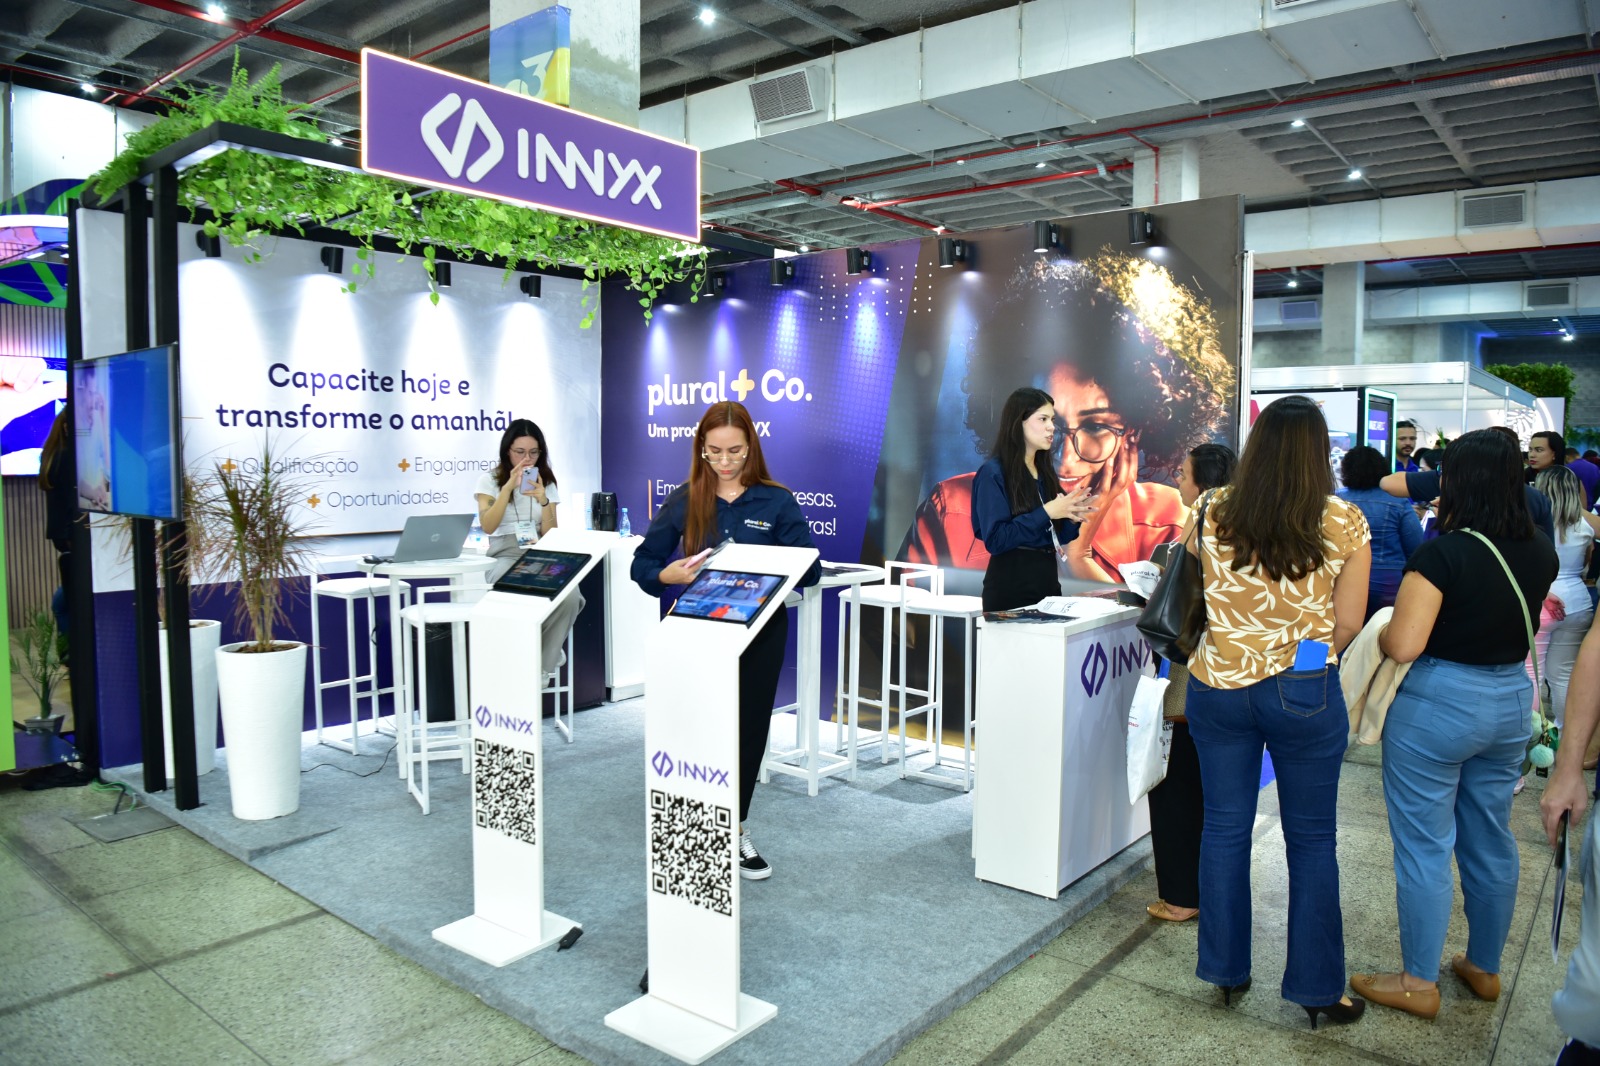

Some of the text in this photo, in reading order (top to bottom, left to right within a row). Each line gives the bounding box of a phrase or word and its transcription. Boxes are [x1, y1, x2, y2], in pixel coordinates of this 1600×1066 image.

[517, 128, 662, 210] INNYX
[268, 362, 470, 401] Capacite hoje e
[647, 370, 728, 416] plural
[761, 368, 813, 402] Co.
[216, 403, 382, 430] transforme
[389, 413, 404, 430] o
[648, 421, 700, 442] Um prod
[243, 457, 359, 477] Qualificação
[415, 457, 501, 475] Engajamen
[327, 489, 449, 511] Oportunidades
[792, 491, 837, 508] resas.
[707, 577, 736, 587] plural
[1112, 638, 1153, 679] INNY
[495, 712, 534, 735] INNYX
[678, 760, 730, 788] INNYX
